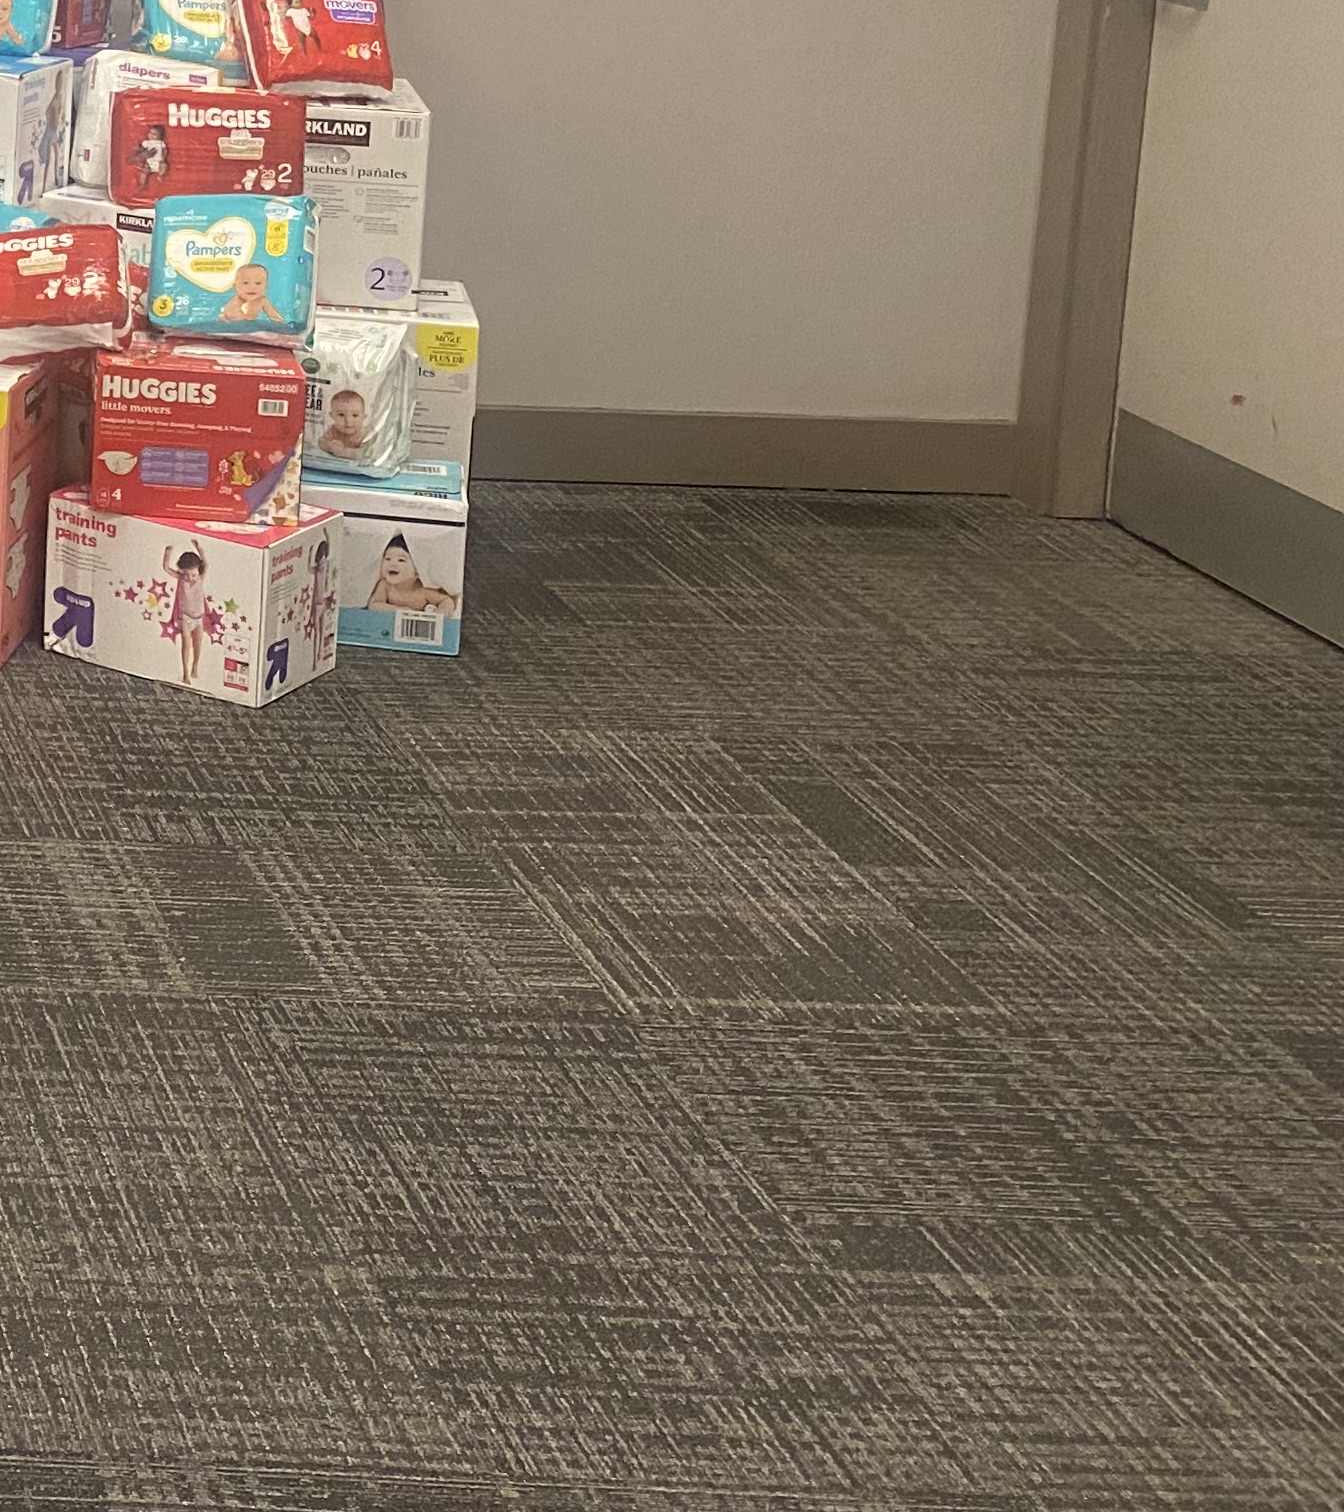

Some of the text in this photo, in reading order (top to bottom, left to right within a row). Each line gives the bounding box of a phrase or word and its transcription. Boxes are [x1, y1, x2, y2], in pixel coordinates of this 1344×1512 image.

[371, 40, 382, 56] 4
[119, 61, 171, 81] diapers
[168, 103, 271, 129] HUGGIES
[261, 163, 292, 182] 29 2
[358, 167, 408, 180] pañales
[186, 240, 242, 258] Pampers
[64, 278, 80, 287] 29
[369, 268, 385, 290] 2
[429, 354, 450, 364] PLUS
[101, 374, 217, 405] HUGGIES
[101, 401, 171, 415] little movers
[111, 489, 122, 500] 4
[55, 507, 117, 537] training
[55, 525, 98, 548] pants
